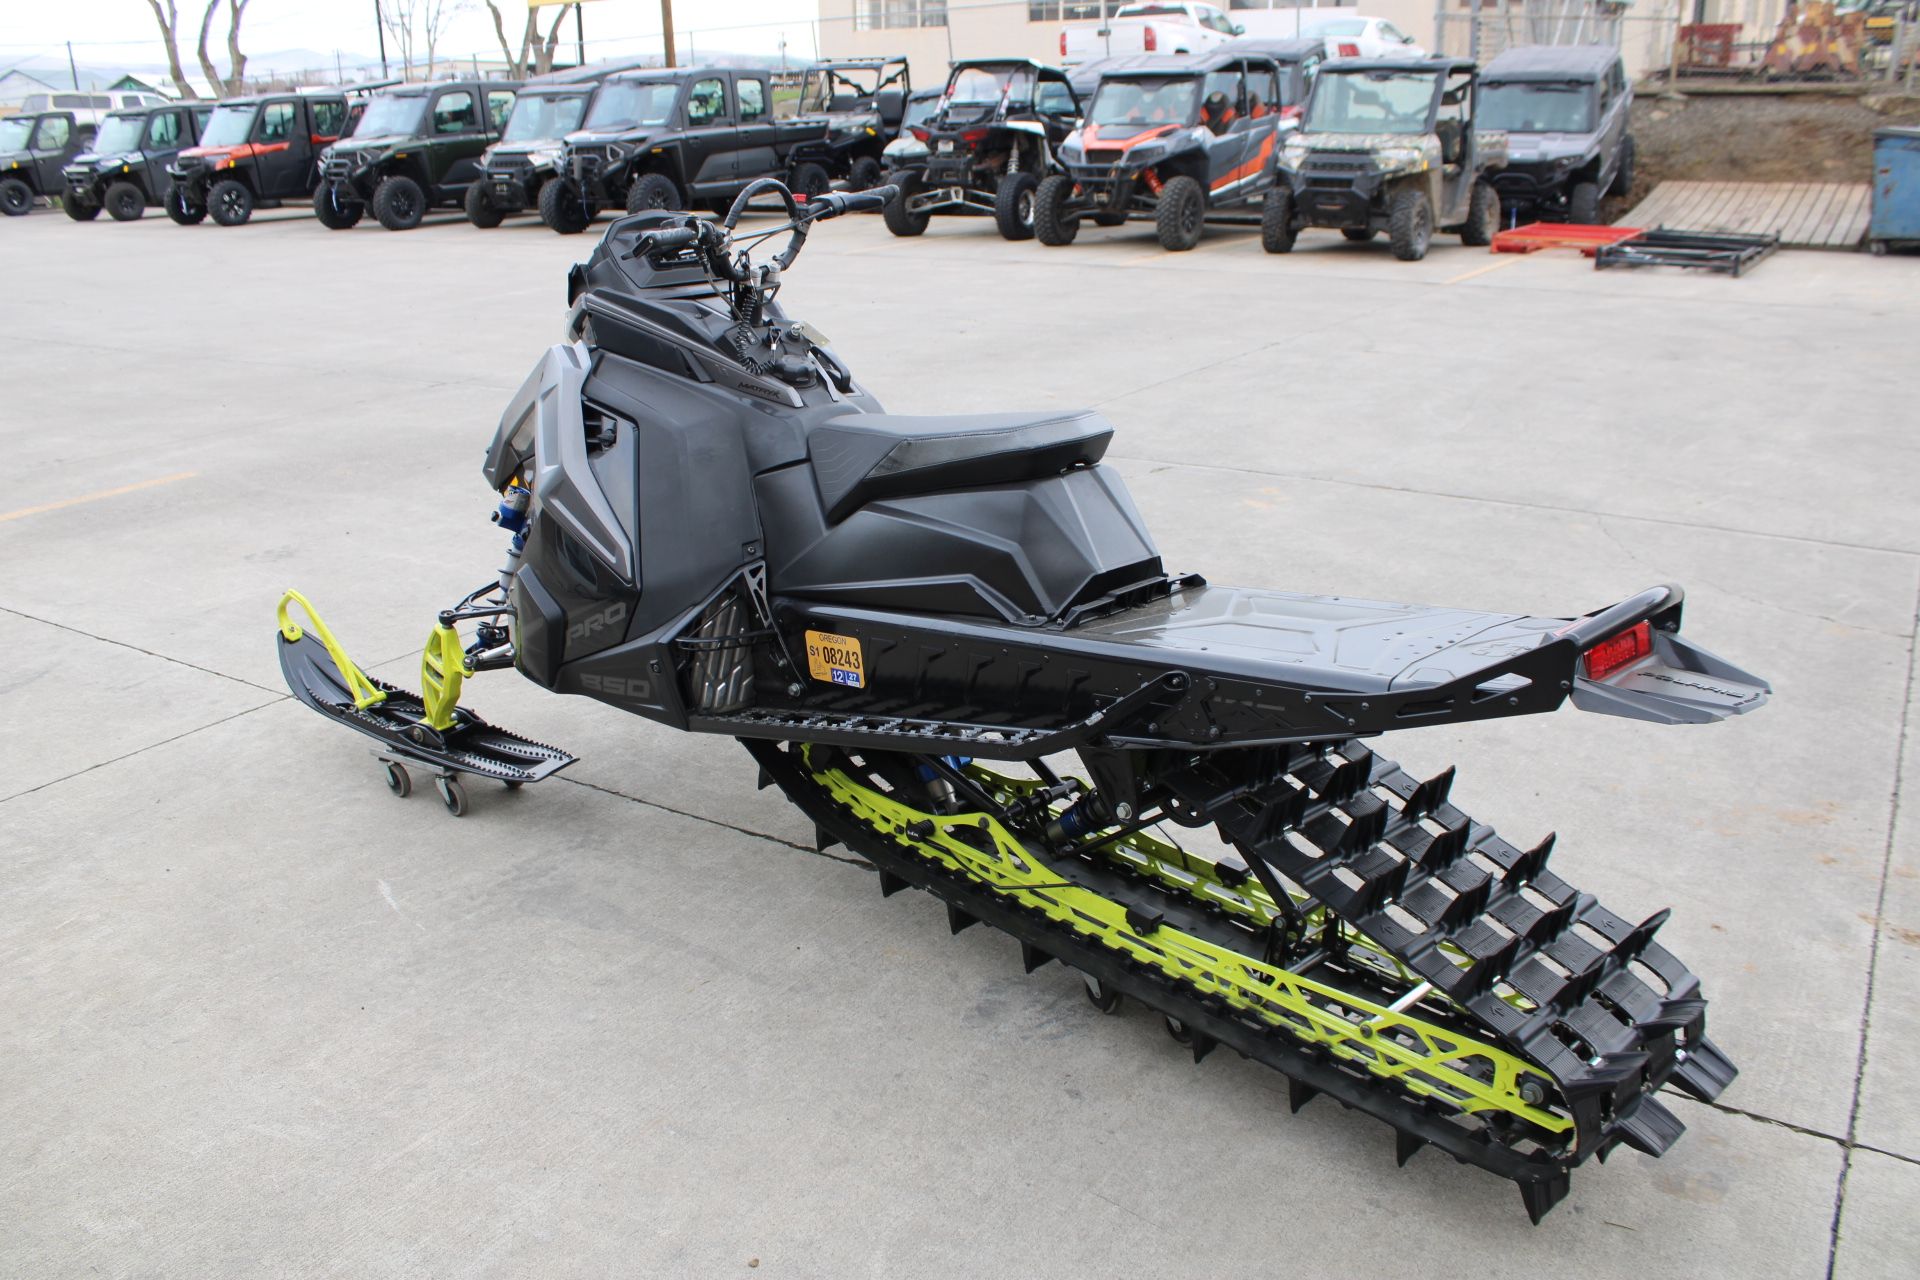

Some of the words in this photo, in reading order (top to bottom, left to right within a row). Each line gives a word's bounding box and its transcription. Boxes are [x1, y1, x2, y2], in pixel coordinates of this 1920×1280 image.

[566, 601, 627, 647] PRO
[818, 633, 847, 646] OREGON
[809, 645, 820, 657] S1
[822, 646, 861, 670] 08243
[580, 672, 651, 699] 850
[832, 670, 845, 683] 12
[848, 673, 858, 683] 27
[1637, 671, 1746, 699] POLARIS
